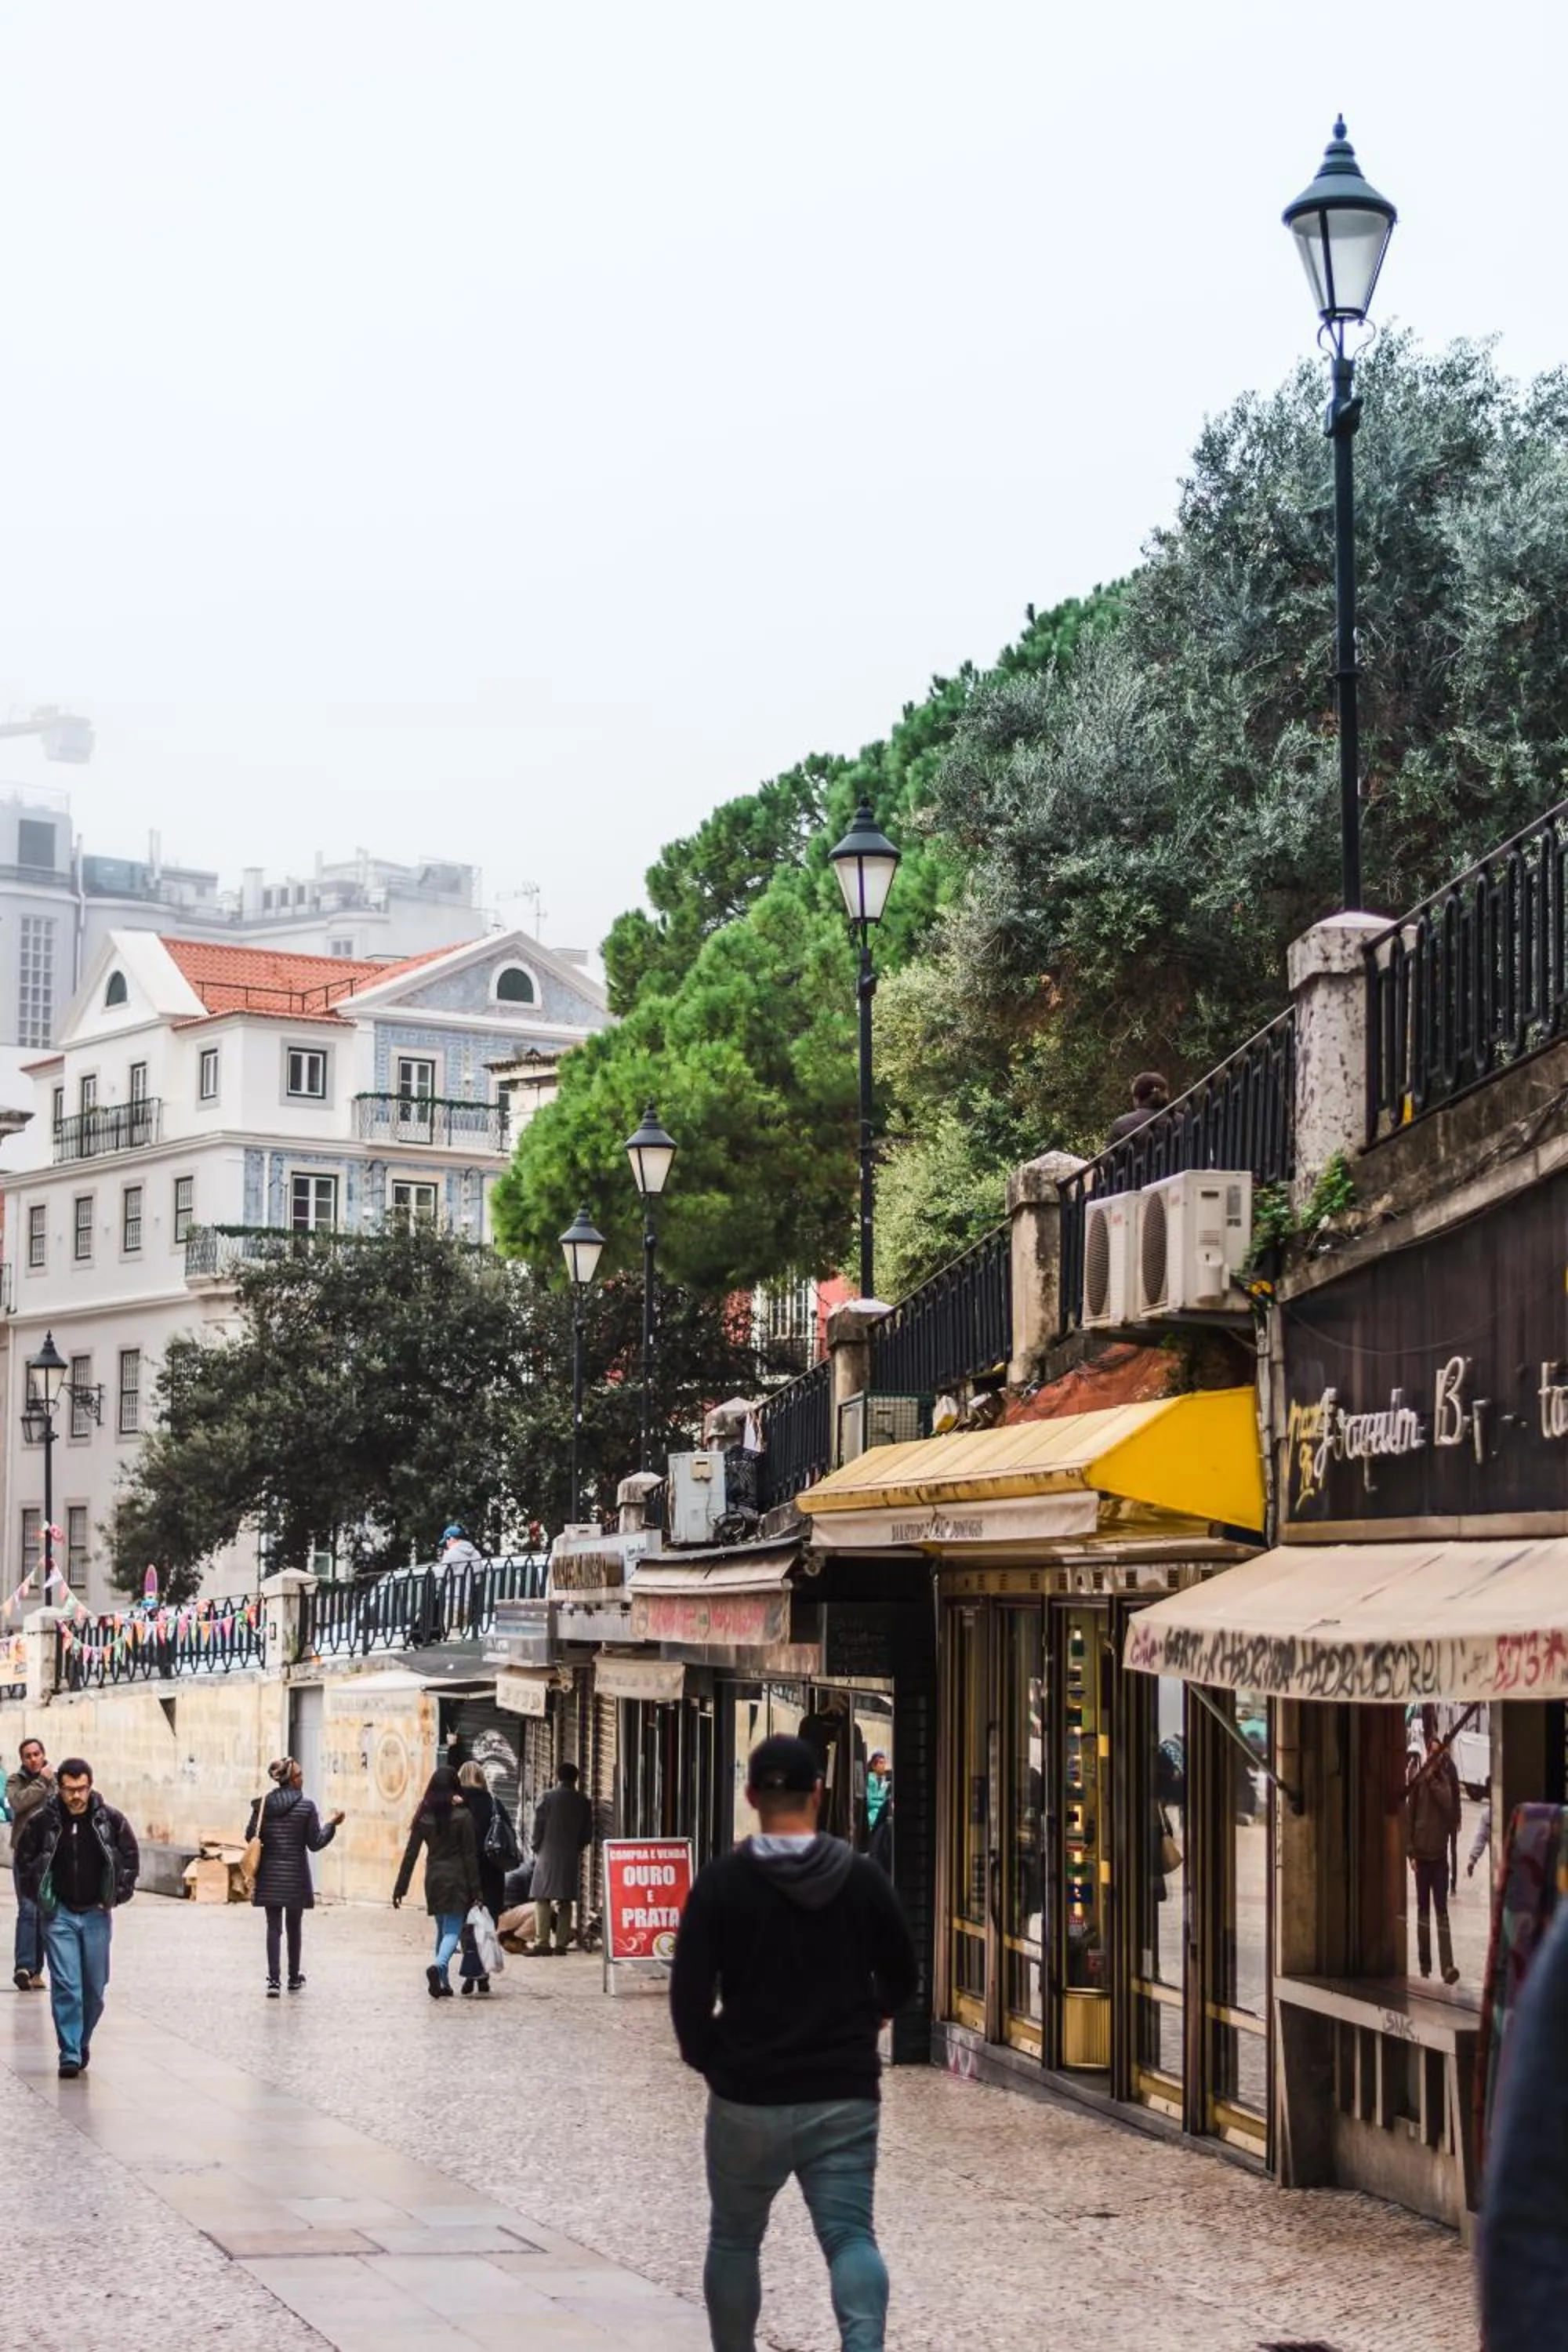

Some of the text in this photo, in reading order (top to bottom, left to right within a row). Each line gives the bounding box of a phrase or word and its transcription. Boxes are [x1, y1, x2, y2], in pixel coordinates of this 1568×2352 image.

[610, 1848, 688, 1860] COMPRA E VENDA
[623, 1865, 676, 1886] OURO
[647, 1889, 655, 1903] E
[621, 1907, 680, 1929] PRATA
